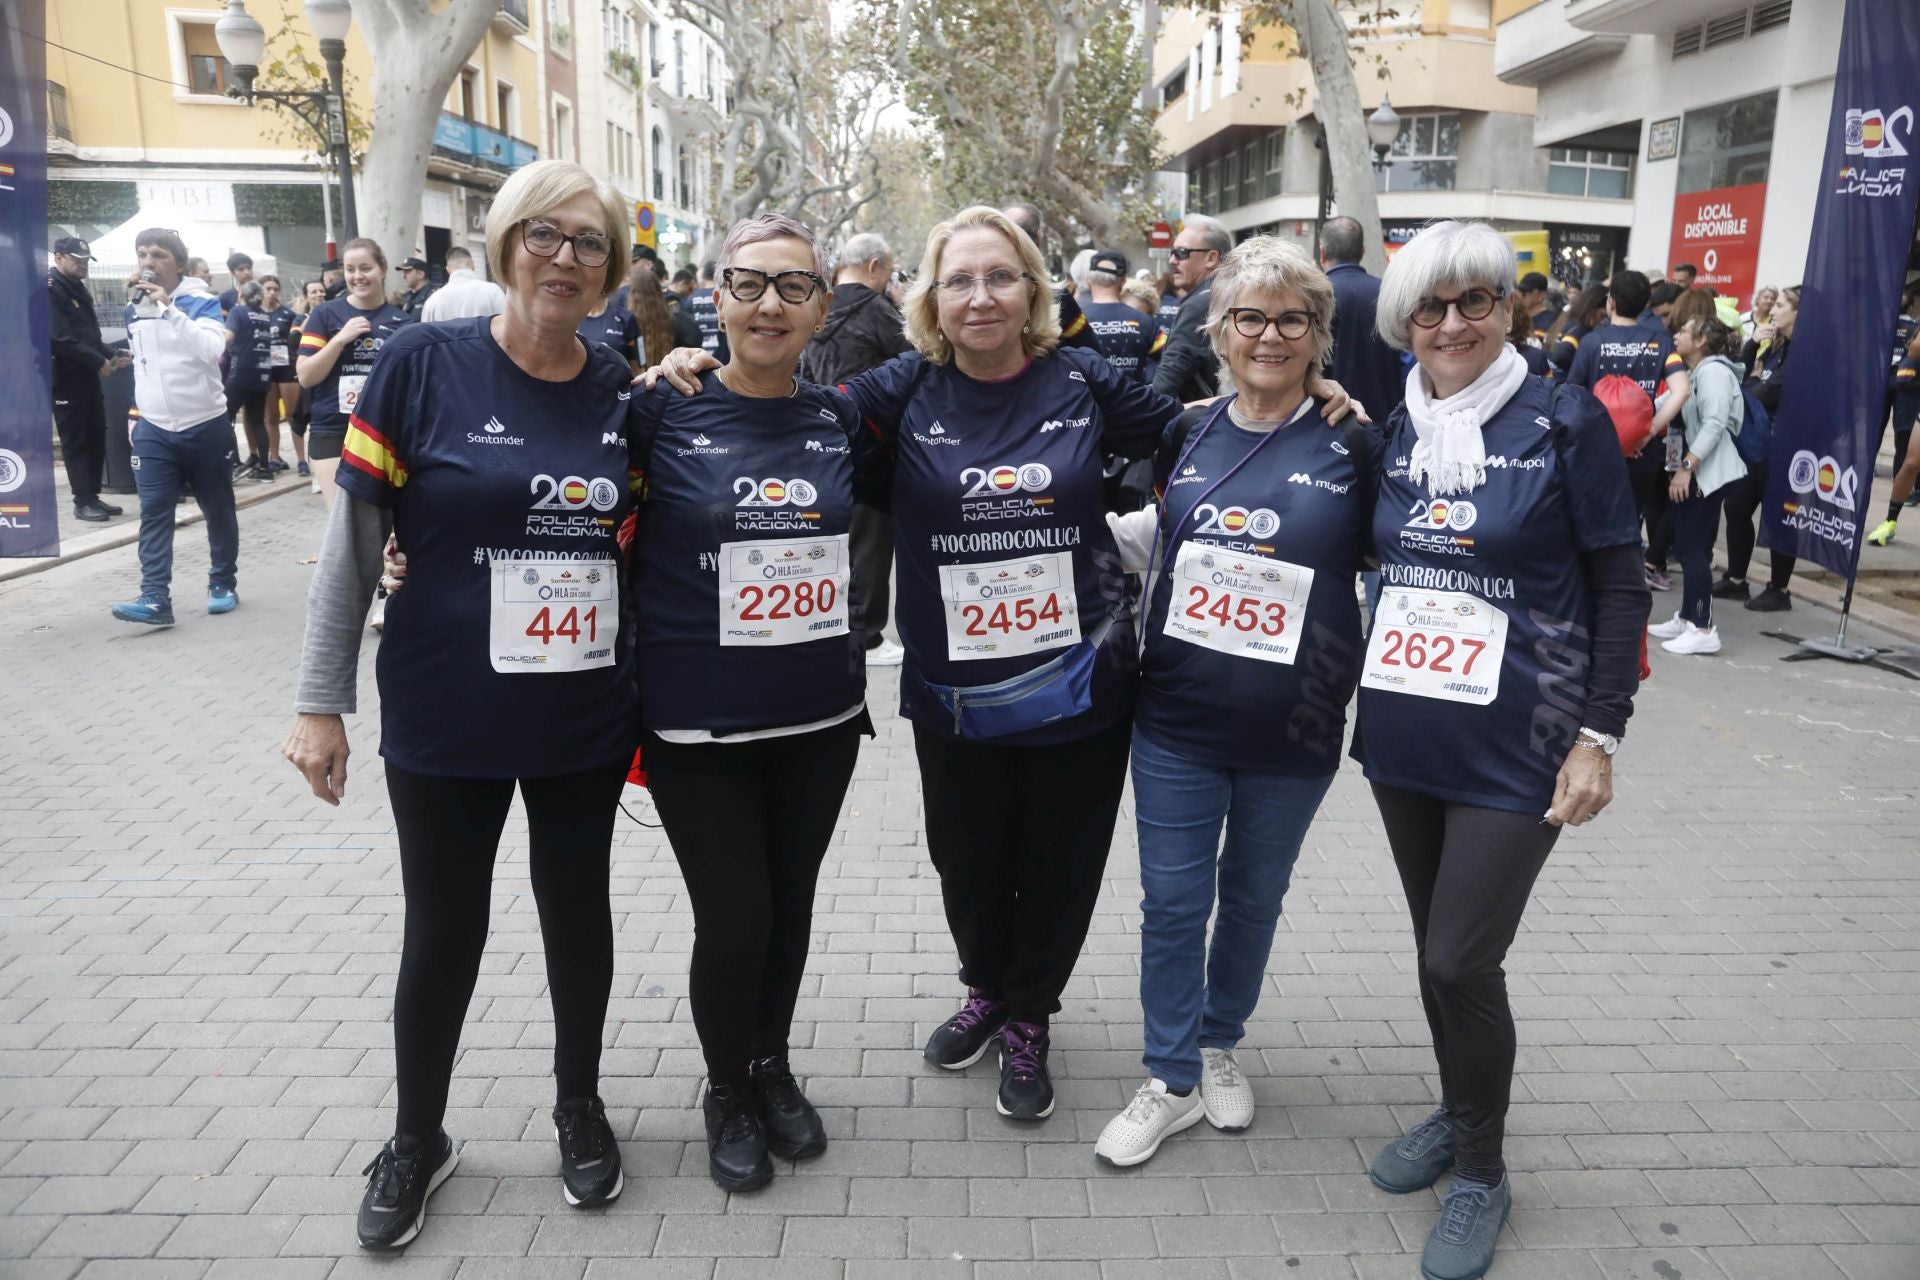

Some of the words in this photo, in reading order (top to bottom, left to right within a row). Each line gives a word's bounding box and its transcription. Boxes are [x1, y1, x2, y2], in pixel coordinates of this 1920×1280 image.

[1697, 203, 1733, 221] LOCAL
[1684, 218, 1748, 239] DISPONIBLE
[467, 432, 525, 446] Santander
[913, 433, 962, 446] Santander
[677, 446, 729, 457] Santander
[1509, 456, 1545, 470] mupol
[959, 462, 1052, 499] 200
[1315, 480, 1349, 495] mupol
[529, 474, 619, 512] 200
[733, 476, 818, 507] 200
[963, 506, 1054, 522] NACIONAL
[1192, 503, 1281, 540] 200
[1404, 498, 1478, 532] 200
[525, 526, 610, 538] NACIONAL
[735, 521, 821, 530] NACIONAL
[931, 526, 1081, 553] #YOCORROCONLUCA
[1401, 540, 1475, 557] NACIONAL
[778, 565, 792, 577] HLA
[1225, 575, 1239, 588] HLA
[554, 587, 568, 598] HLA
[994, 585, 1009, 596] HLA
[740, 579, 836, 620] 2280
[962, 592, 1063, 636] 2454
[1185, 585, 1287, 637] 2453
[526, 606, 597, 644] 441
[808, 618, 843, 631] #RUTA091
[1418, 614, 1432, 626] HLA
[1034, 628, 1073, 644] #RUTA091
[1245, 641, 1289, 655] #RUTA091
[1380, 629, 1487, 676] 2627
[1443, 683, 1489, 696] #RUTA091
